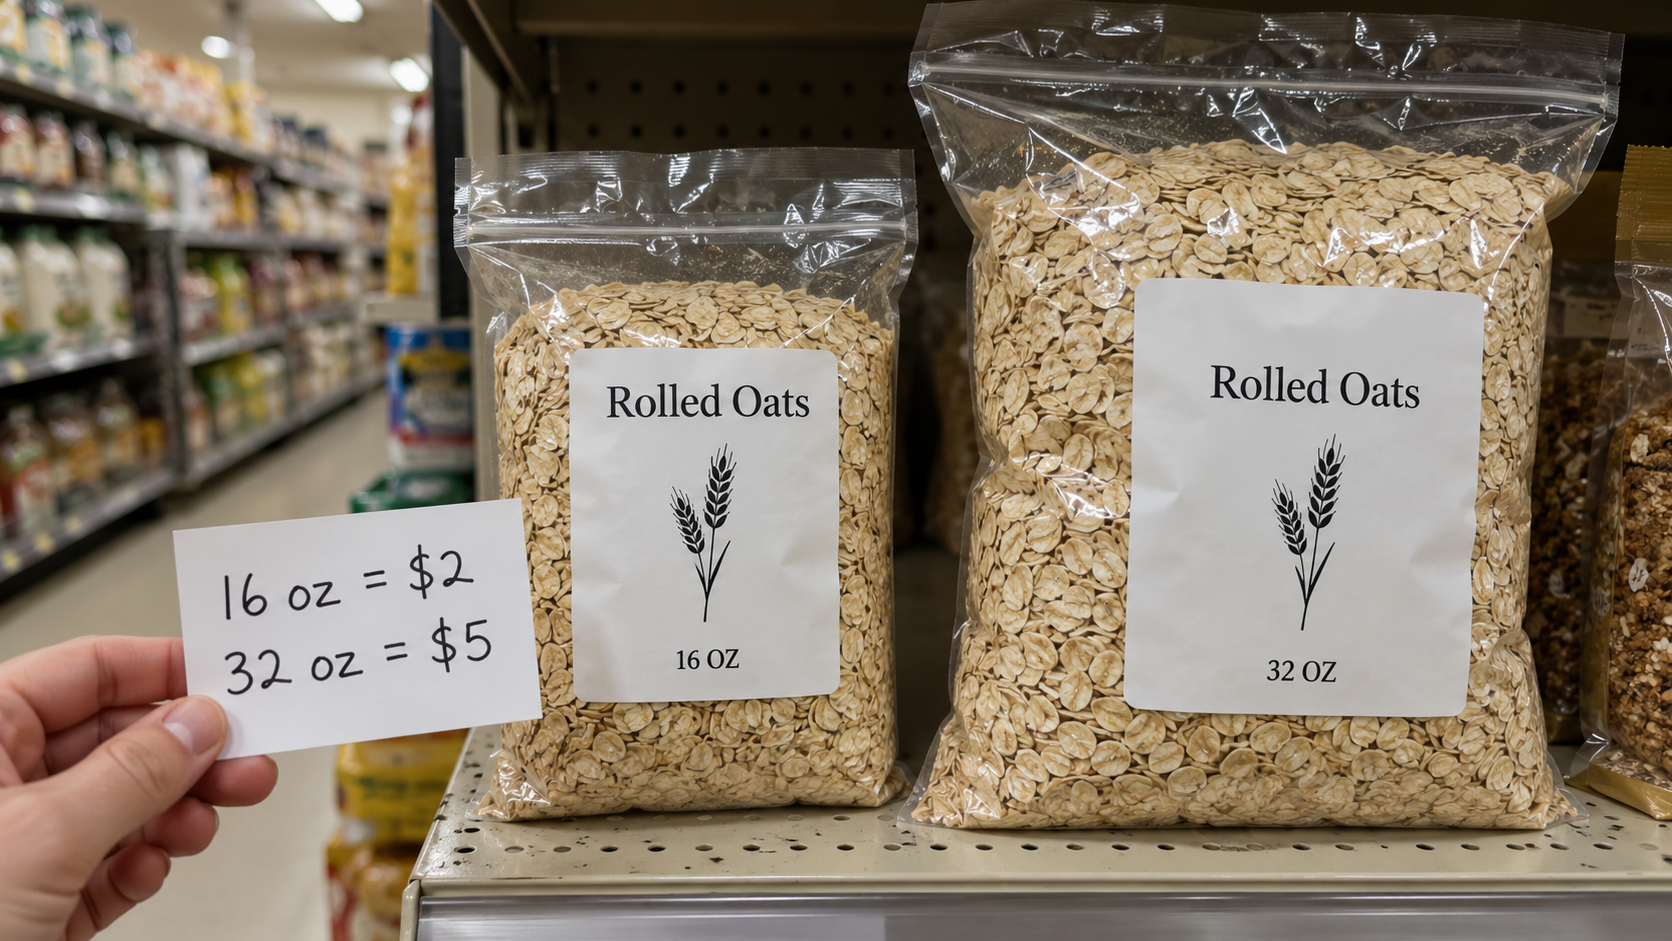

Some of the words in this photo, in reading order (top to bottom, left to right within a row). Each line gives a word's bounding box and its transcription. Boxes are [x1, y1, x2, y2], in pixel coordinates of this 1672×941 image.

[606, 382, 723, 419] Rolled
[732, 384, 810, 418] Oats
[1210, 364, 1330, 405] Rolled
[1339, 371, 1420, 409] Oats
[224, 575, 268, 621] 16
[288, 581, 342, 611] oz
[363, 569, 388, 590] =
[409, 544, 475, 600] $2
[224, 649, 293, 696] 32
[311, 651, 364, 682] oz
[383, 642, 408, 662] =
[431, 616, 492, 673] $5
[676, 649, 701, 670] 16
[706, 648, 740, 670] OZ
[1266, 659, 1295, 682] 32
[1301, 660, 1337, 683] OZ
